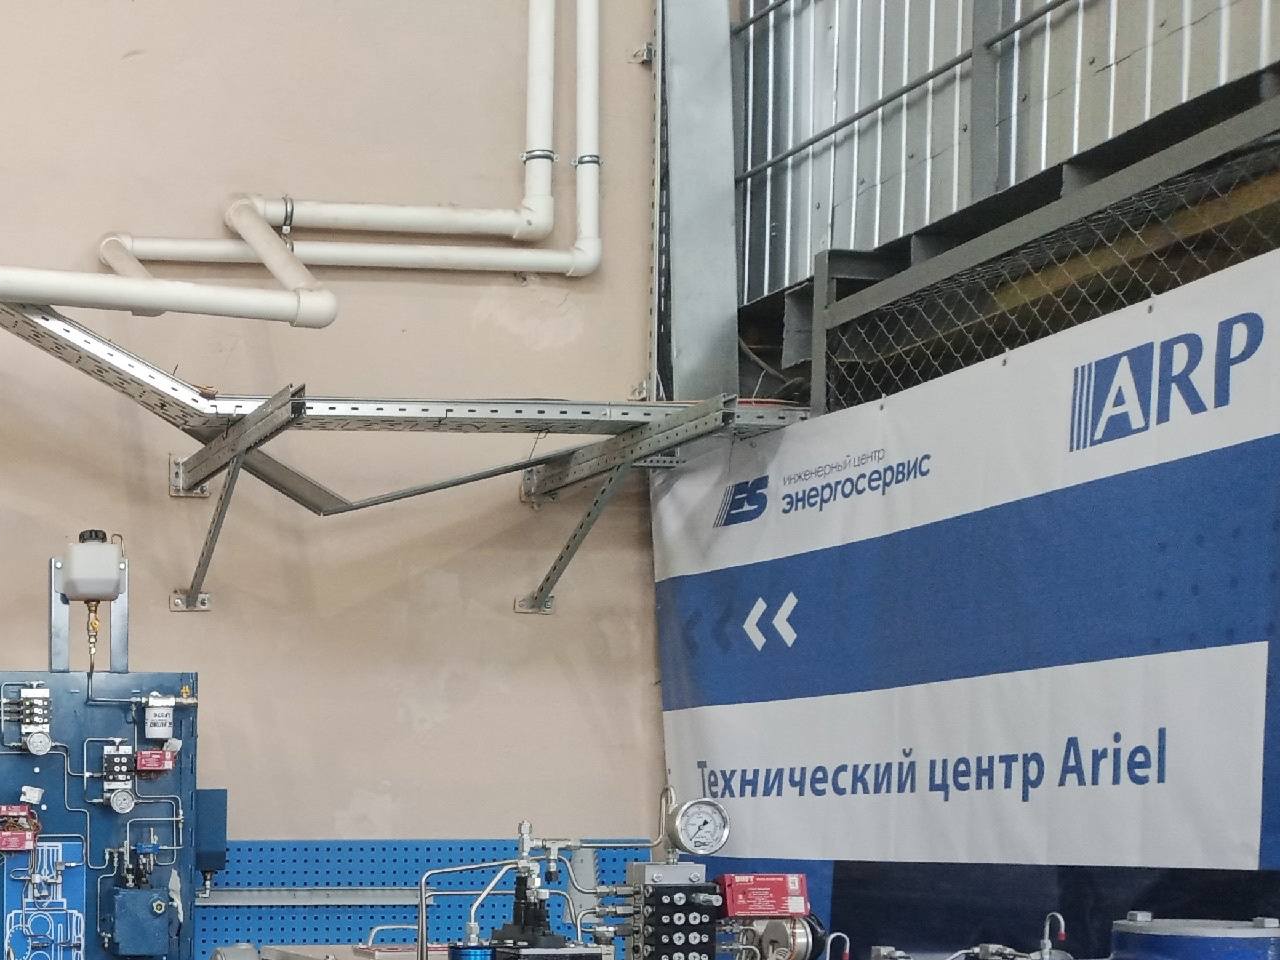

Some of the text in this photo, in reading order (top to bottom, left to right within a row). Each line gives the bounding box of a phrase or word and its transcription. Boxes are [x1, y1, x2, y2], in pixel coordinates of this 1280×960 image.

[1091, 312, 1264, 446] ARP
[782, 454, 931, 513] энергосервис
[783, 448, 886, 485] инженерный центр
[697, 727, 1167, 803] Технический центр Ariel
